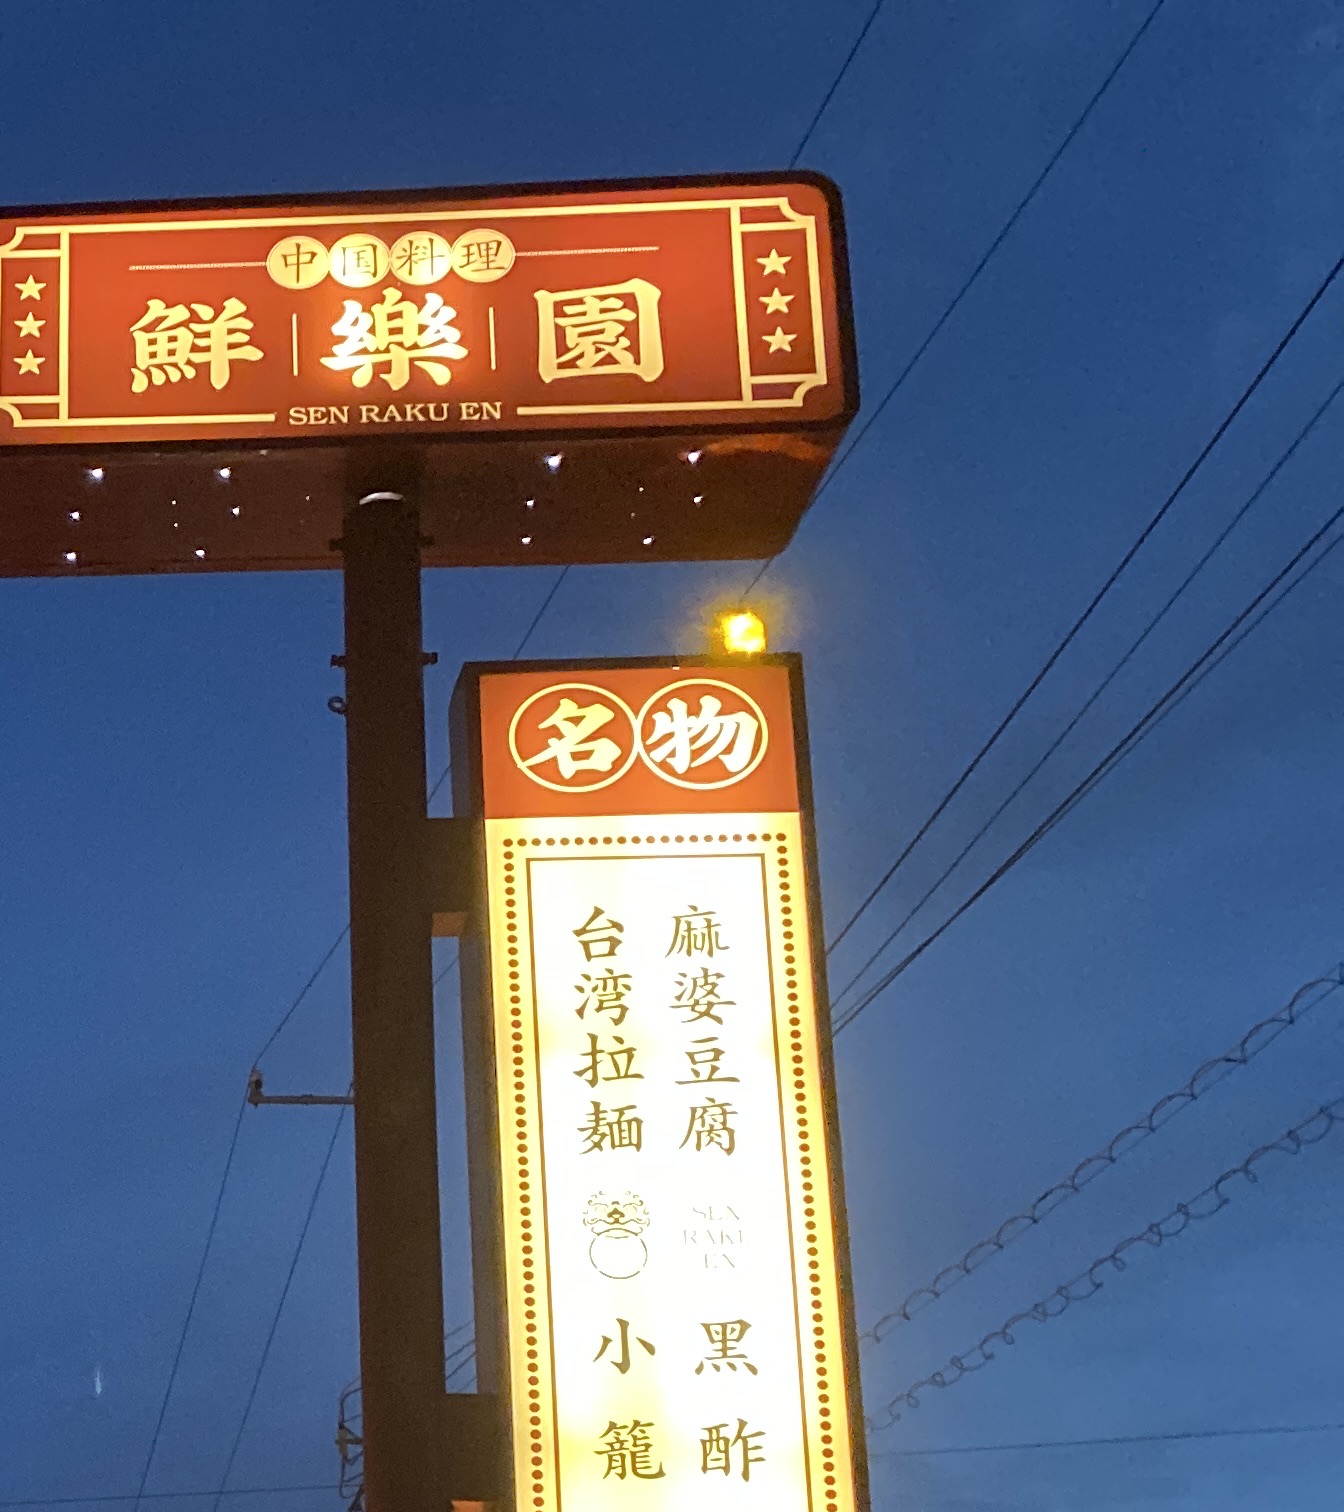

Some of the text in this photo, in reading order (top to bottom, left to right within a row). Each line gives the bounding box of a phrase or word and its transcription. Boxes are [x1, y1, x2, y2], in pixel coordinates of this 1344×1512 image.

[281, 236, 506, 277] 中国料理
[289, 402, 502, 425] SEN RAKU EN
[517, 695, 759, 779] 名物
[571, 905, 645, 1157] 台湾拉麺
[665, 904, 741, 1157] 麻婆豆腐
